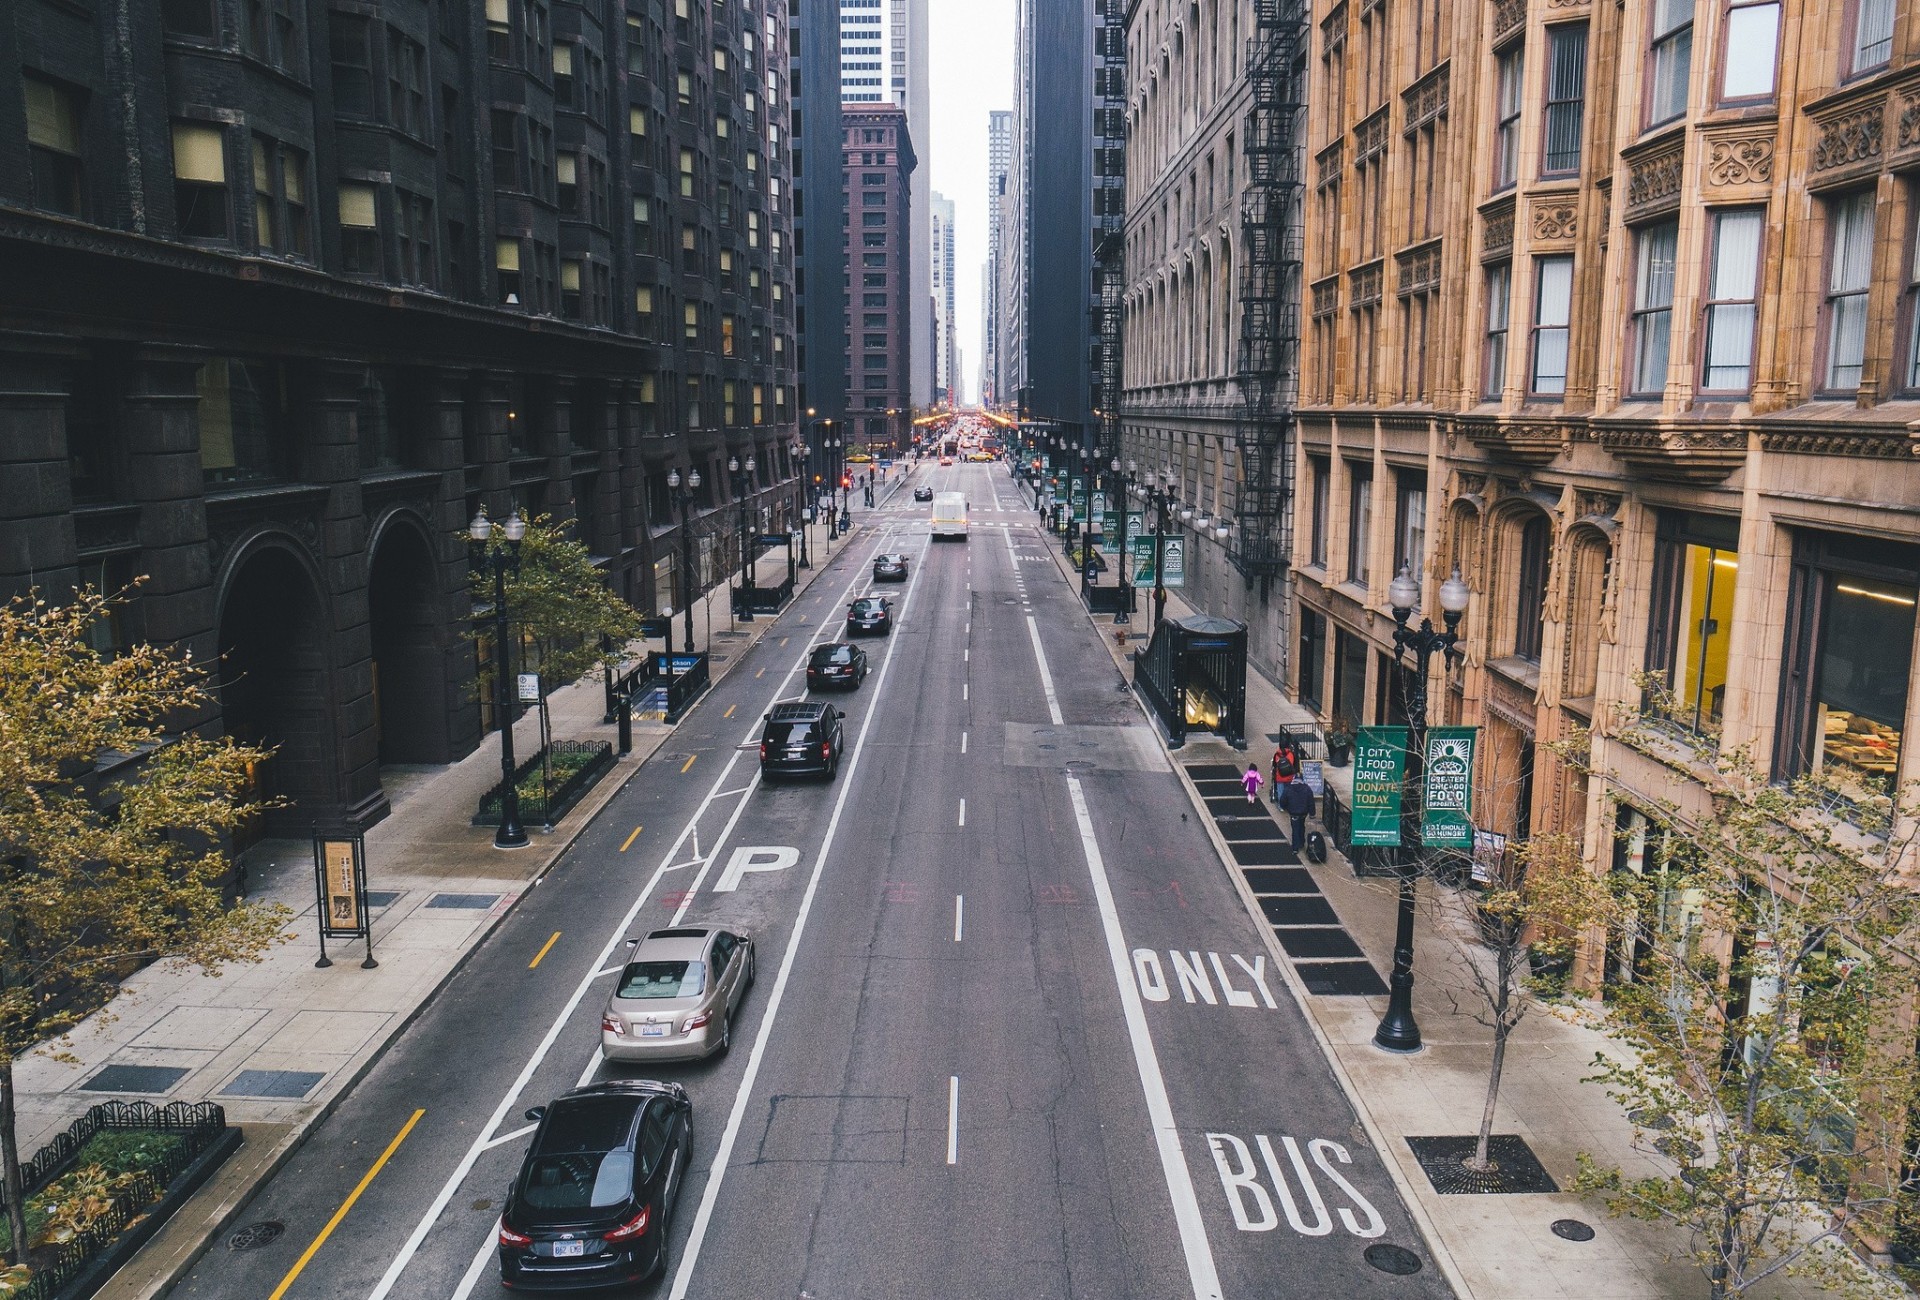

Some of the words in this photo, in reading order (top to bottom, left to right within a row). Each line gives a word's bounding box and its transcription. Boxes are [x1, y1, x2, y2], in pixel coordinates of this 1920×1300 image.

[1358, 746, 1365, 757] 1
[1367, 748, 1392, 759] CITY,
[1357, 757, 1364, 768] 1
[1366, 759, 1396, 770] FOOD
[1356, 770, 1390, 781] DRIVE.
[1430, 775, 1465, 783] GREATER
[1355, 782, 1398, 793] DONATE
[1355, 794, 1389, 804] TODAY.
[1429, 790, 1465, 801] FOOD
[713, 846, 800, 892] P
[1132, 948, 1278, 1009] ONLY
[1205, 1131, 1388, 1239] BUS
